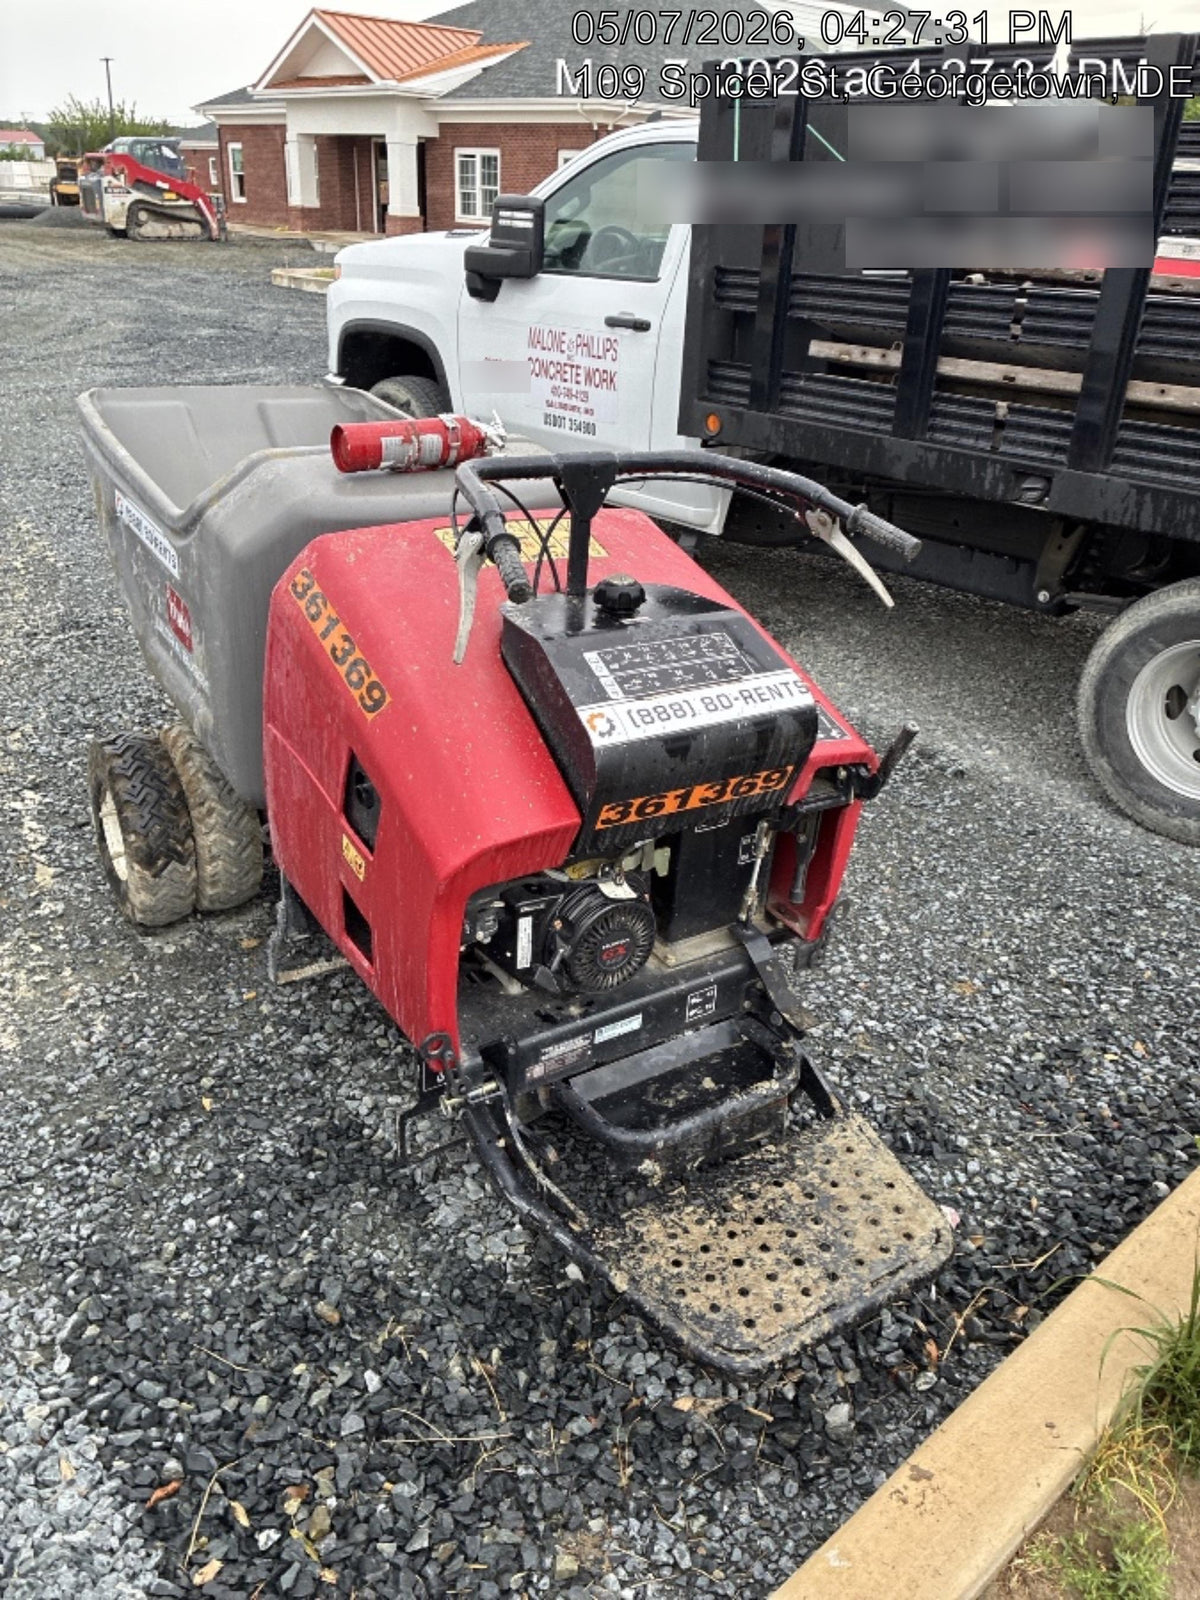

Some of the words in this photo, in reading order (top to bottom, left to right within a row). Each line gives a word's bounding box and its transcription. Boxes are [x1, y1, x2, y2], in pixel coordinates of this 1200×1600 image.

[528, 327, 566, 353] MALONE
[576, 334, 619, 361] PHILLIPS
[583, 366, 617, 391] WORK
[290, 569, 387, 714] 361369
[626, 700, 697, 729] (888)
[601, 769, 786, 825] 361369
